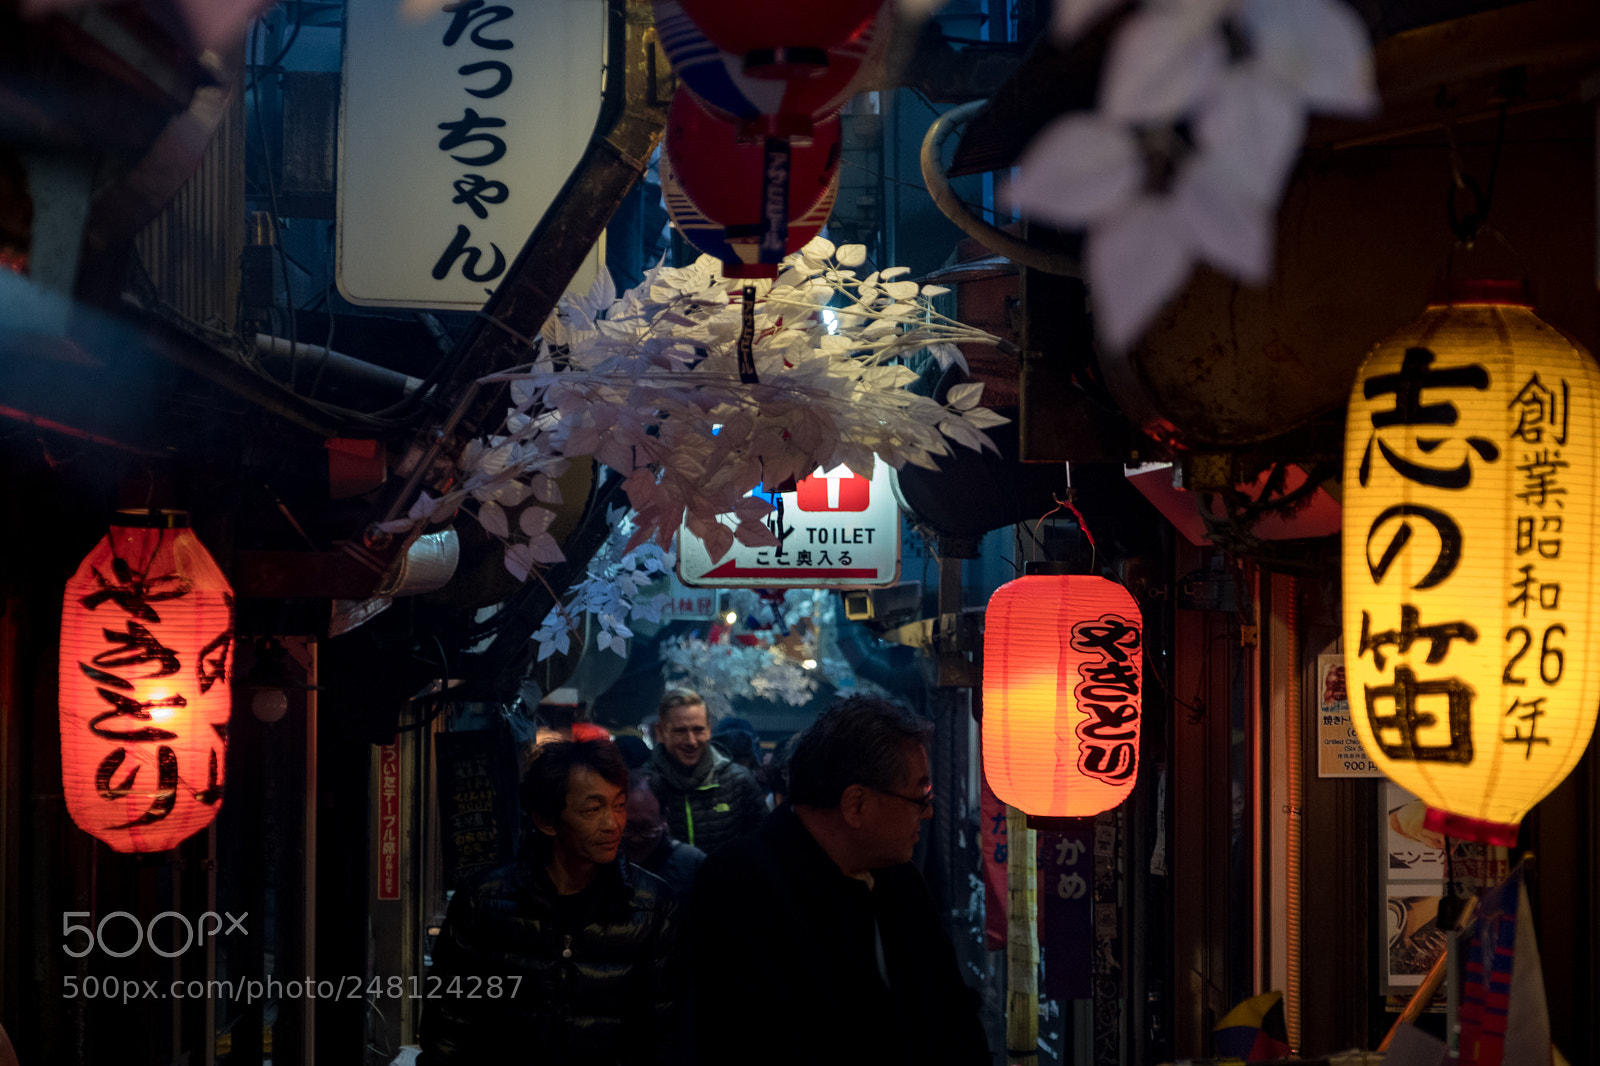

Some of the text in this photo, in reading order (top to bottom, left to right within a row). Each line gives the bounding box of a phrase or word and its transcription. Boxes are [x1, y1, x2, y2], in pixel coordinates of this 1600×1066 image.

[432, 0, 514, 283] たっちゃん
[756, 550, 853, 567] ここ奥入る
[807, 527, 876, 544] TOILET
[1502, 371, 1570, 761] 創業昭和26年
[1073, 617, 1142, 783] やきとり
[1344, 761, 1365, 771] 900
[1055, 837, 1088, 900] かめ
